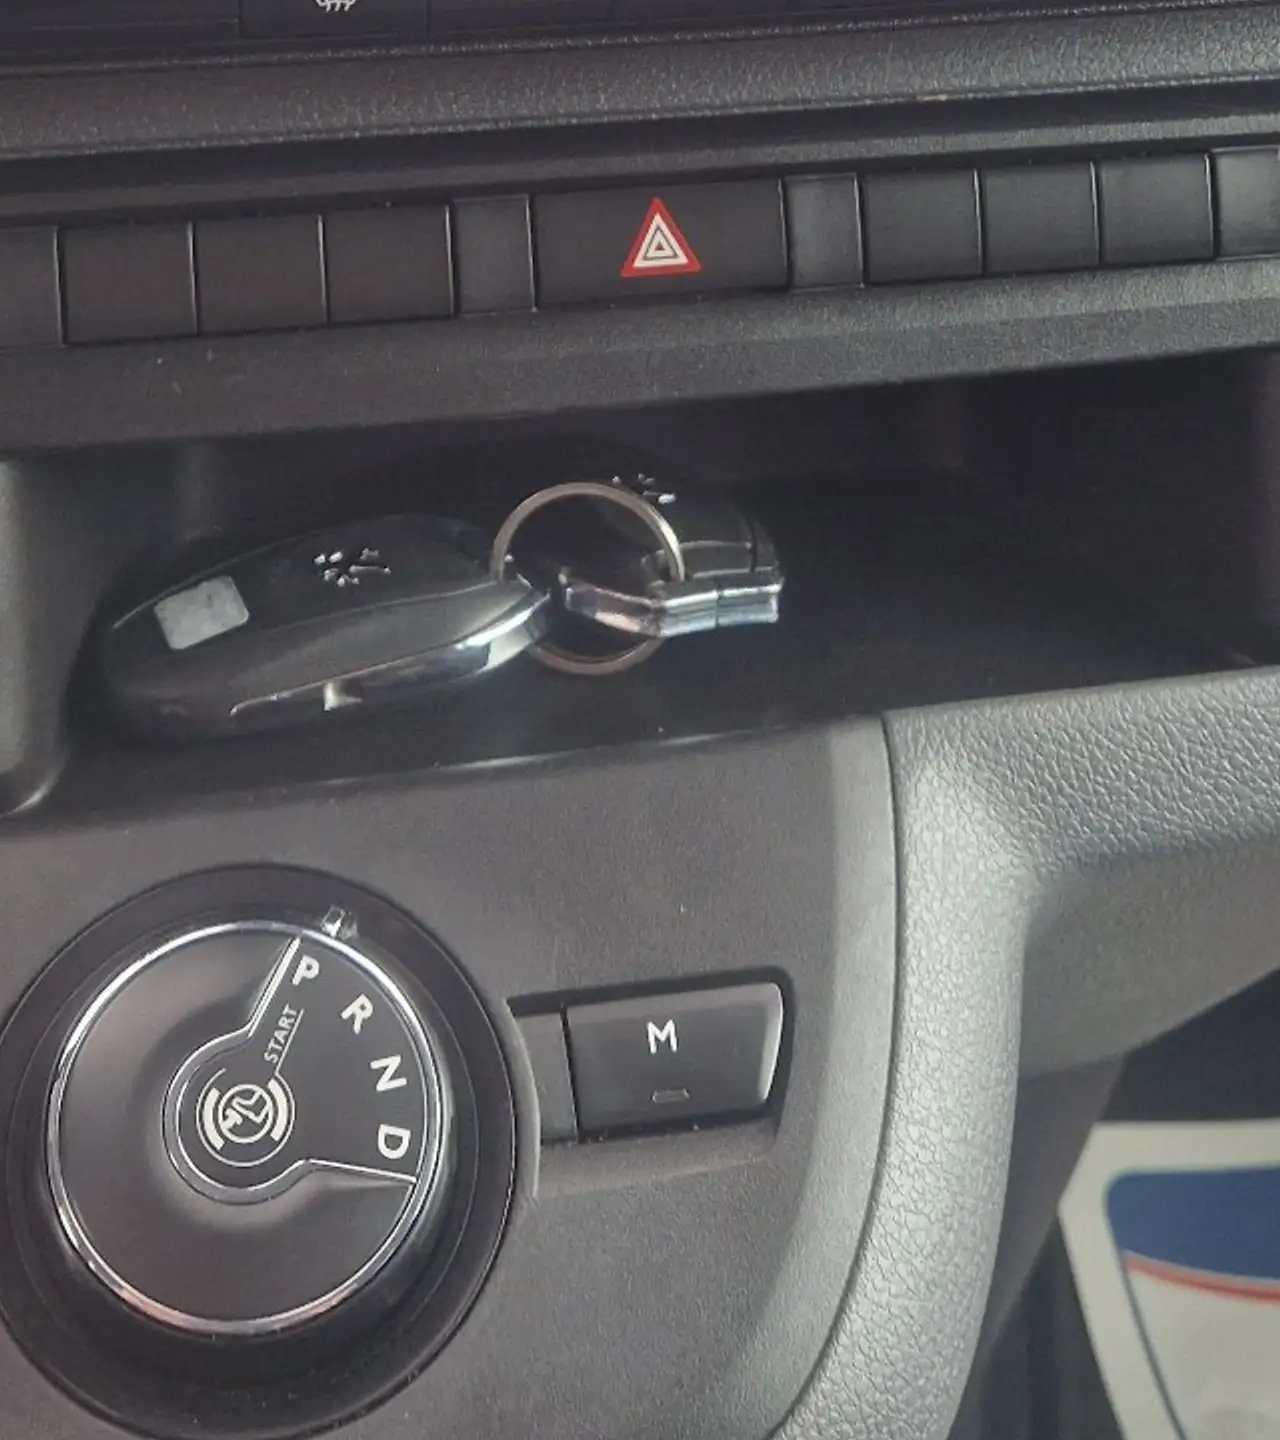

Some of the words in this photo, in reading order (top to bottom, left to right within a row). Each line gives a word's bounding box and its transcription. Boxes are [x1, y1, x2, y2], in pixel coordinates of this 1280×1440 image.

[292, 954, 320, 986] P
[340, 994, 374, 1035] R
[264, 1004, 297, 1063] START
[647, 1020, 677, 1055] M
[370, 1054, 407, 1092] N
[377, 1123, 411, 1159] D
